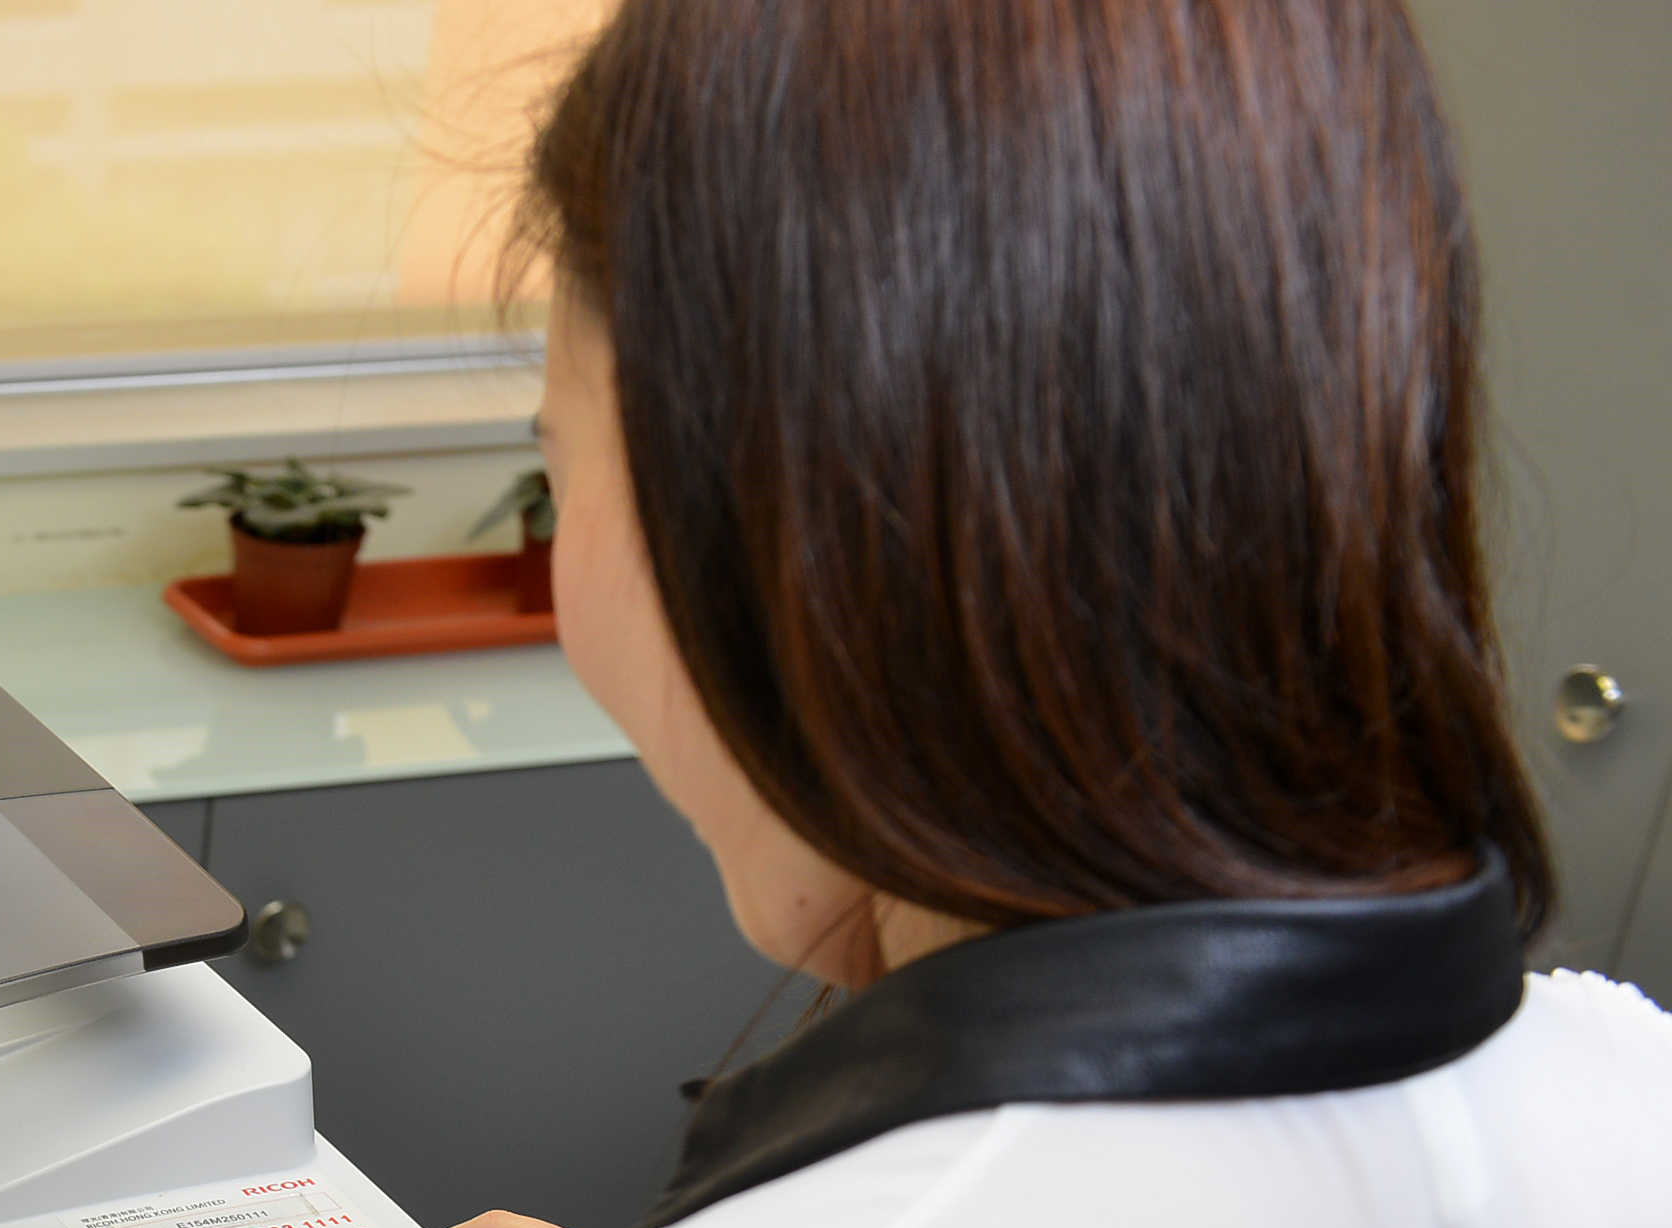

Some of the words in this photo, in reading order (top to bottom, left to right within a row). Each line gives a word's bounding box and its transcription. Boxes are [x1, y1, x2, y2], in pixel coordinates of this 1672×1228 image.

[241, 1178, 316, 1196] RICOH
[119, 1212, 153, 1225] HONG
[154, 1205, 186, 1218] KONG
[186, 1199, 226, 1211] LIMITED
[303, 1215, 353, 1228] 1111
